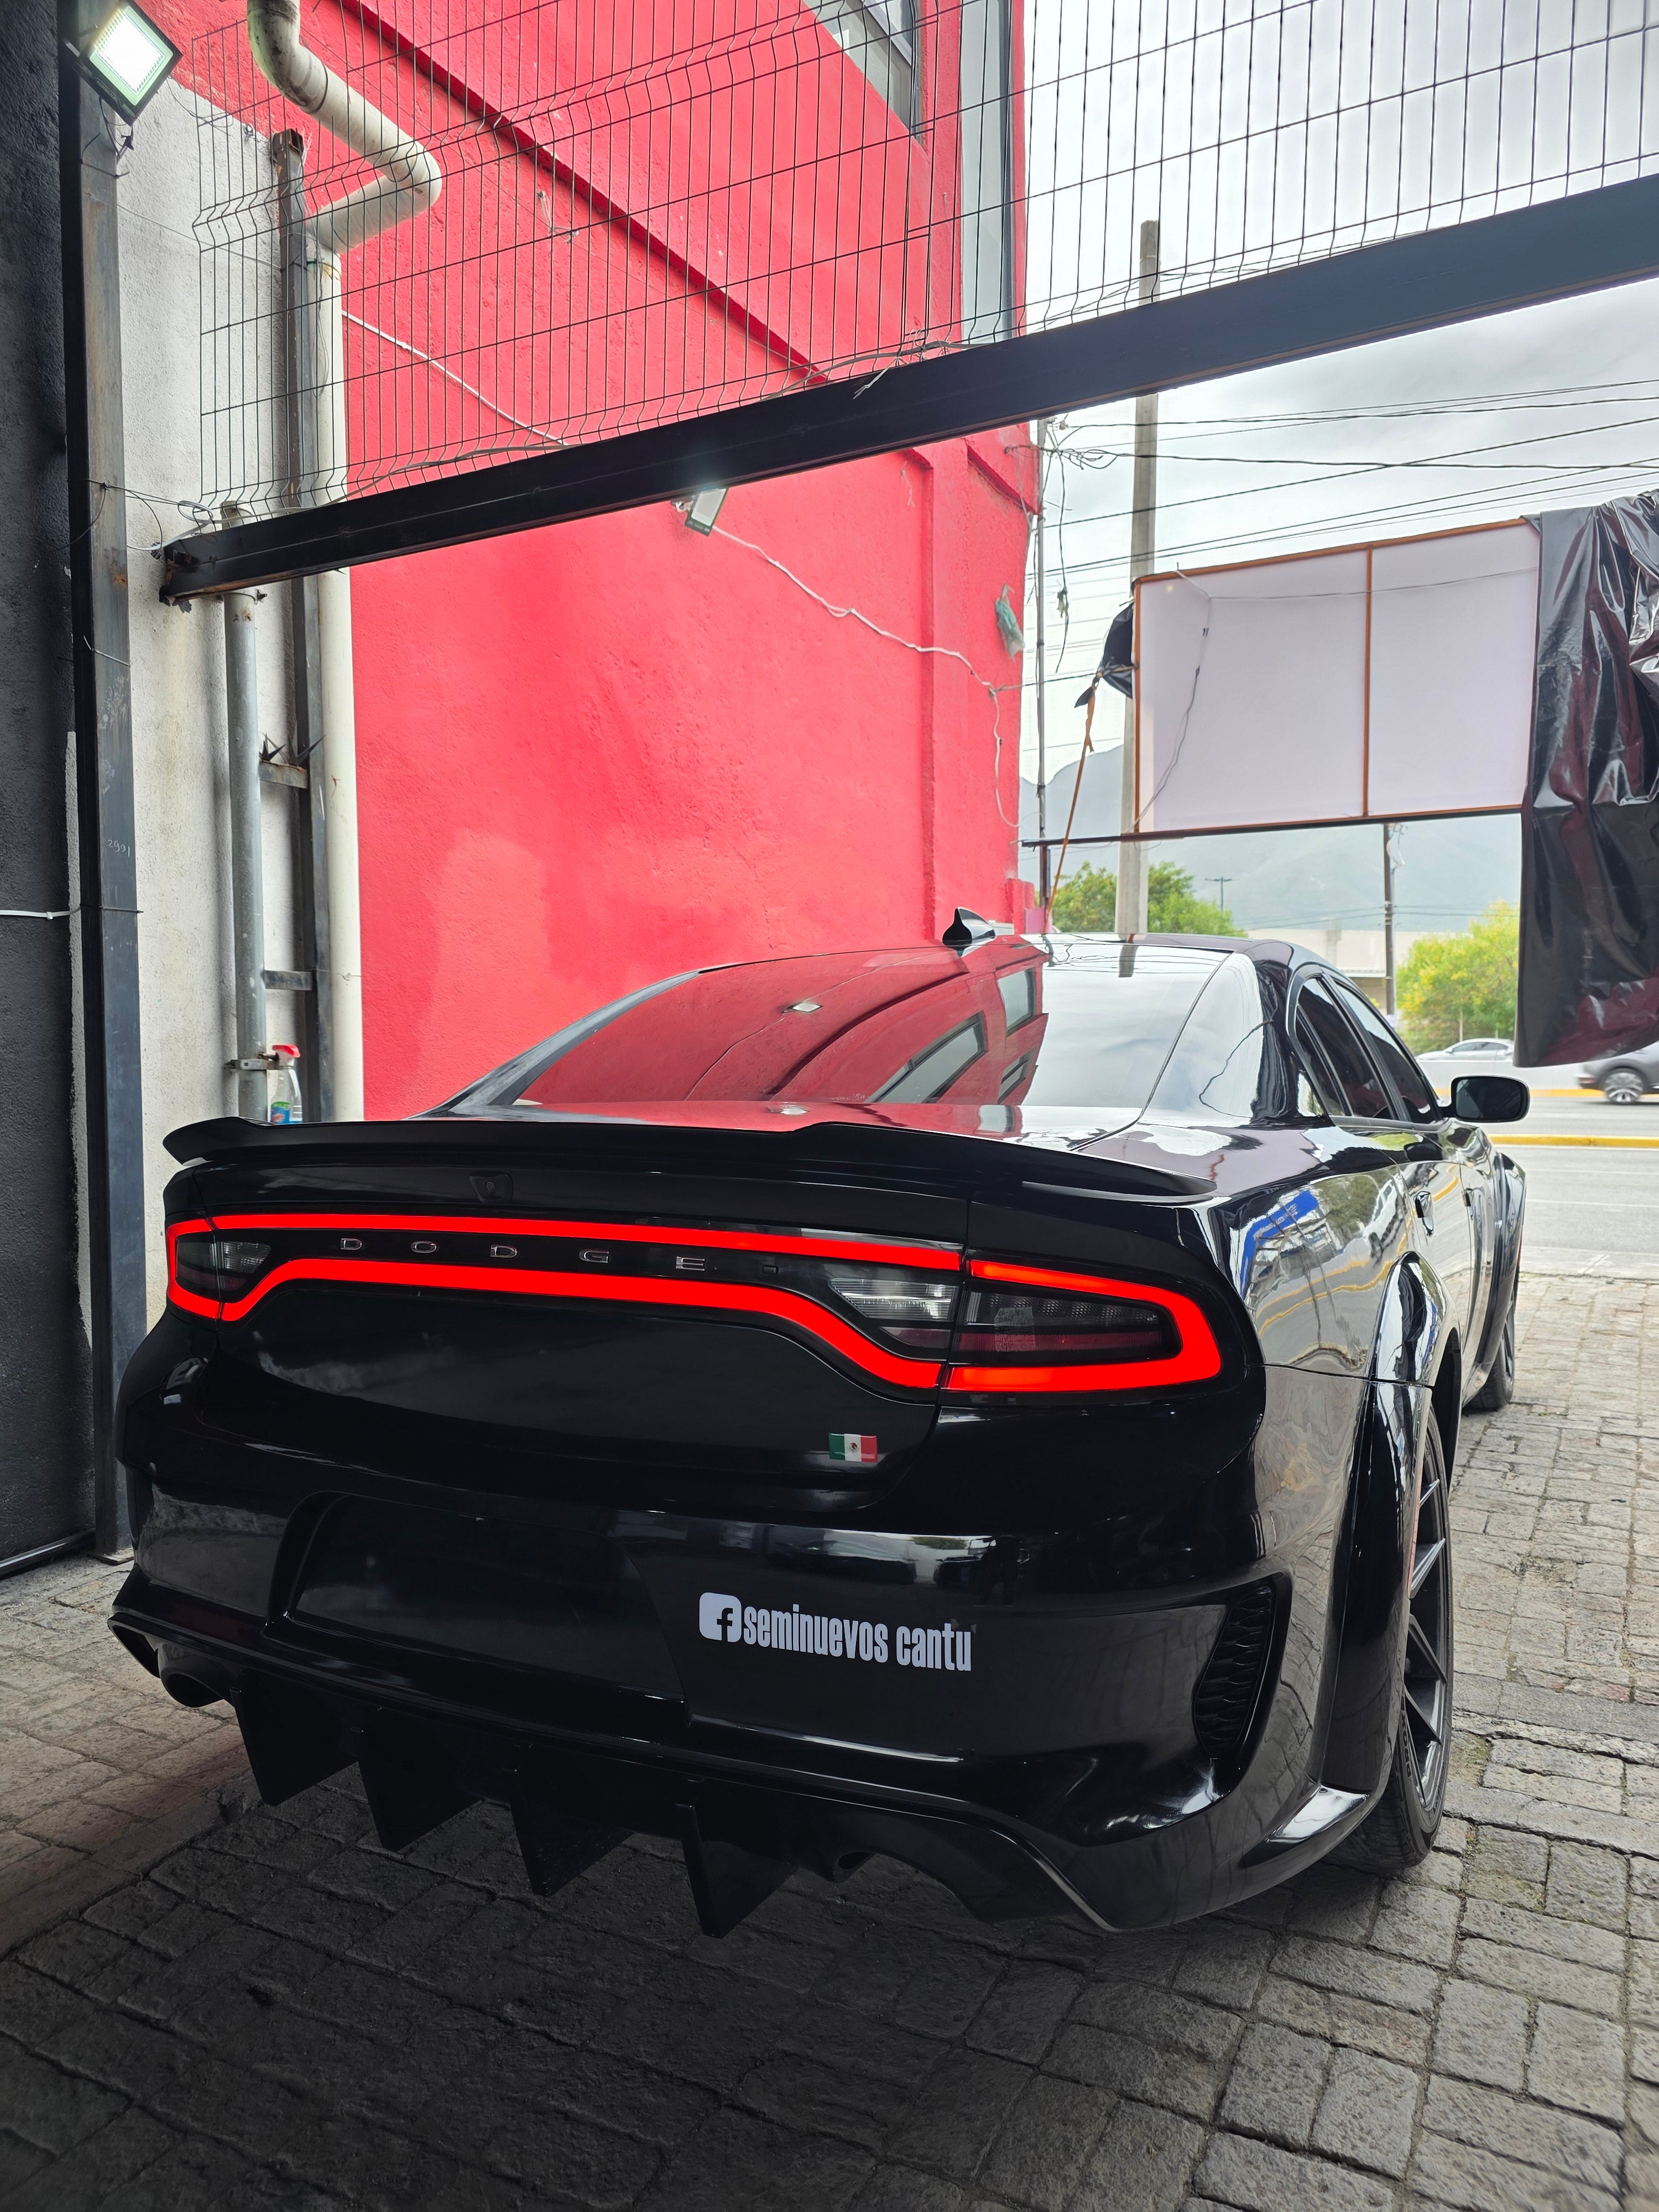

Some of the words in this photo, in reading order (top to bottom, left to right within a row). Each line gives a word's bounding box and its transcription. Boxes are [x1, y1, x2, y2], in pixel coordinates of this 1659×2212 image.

[340, 1238, 706, 1272] DODGE
[743, 1604, 888, 1663] seminuevos
[896, 1623, 972, 1672] cantu
